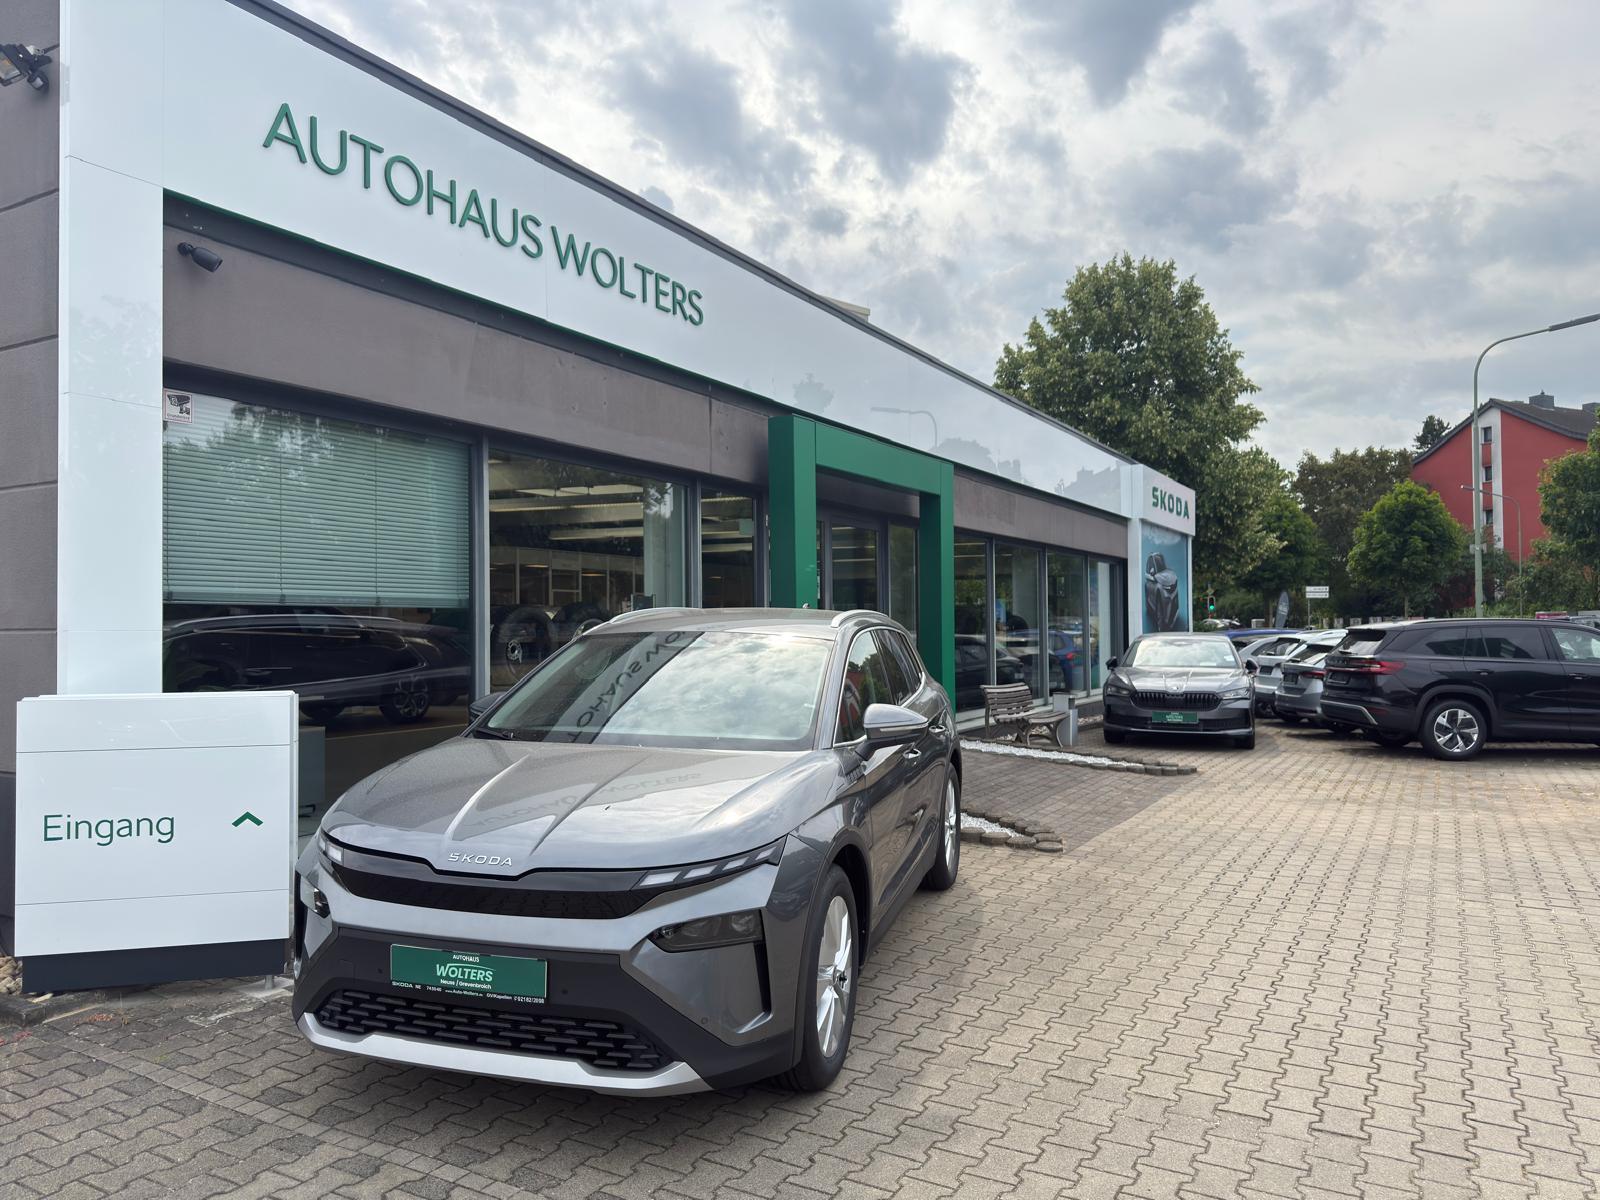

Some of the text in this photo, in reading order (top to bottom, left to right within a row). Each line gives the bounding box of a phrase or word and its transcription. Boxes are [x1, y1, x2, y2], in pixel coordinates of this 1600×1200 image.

[262, 102, 705, 327] AUTOHAUS WOLTERS
[1151, 485, 1190, 520] SKODA
[43, 814, 175, 847] Eingang
[447, 852, 513, 867] SKODA
[452, 954, 480, 963] AUTOHAUS
[436, 963, 495, 982] WOLTERS
[459, 981, 492, 989] Grevenbroich
